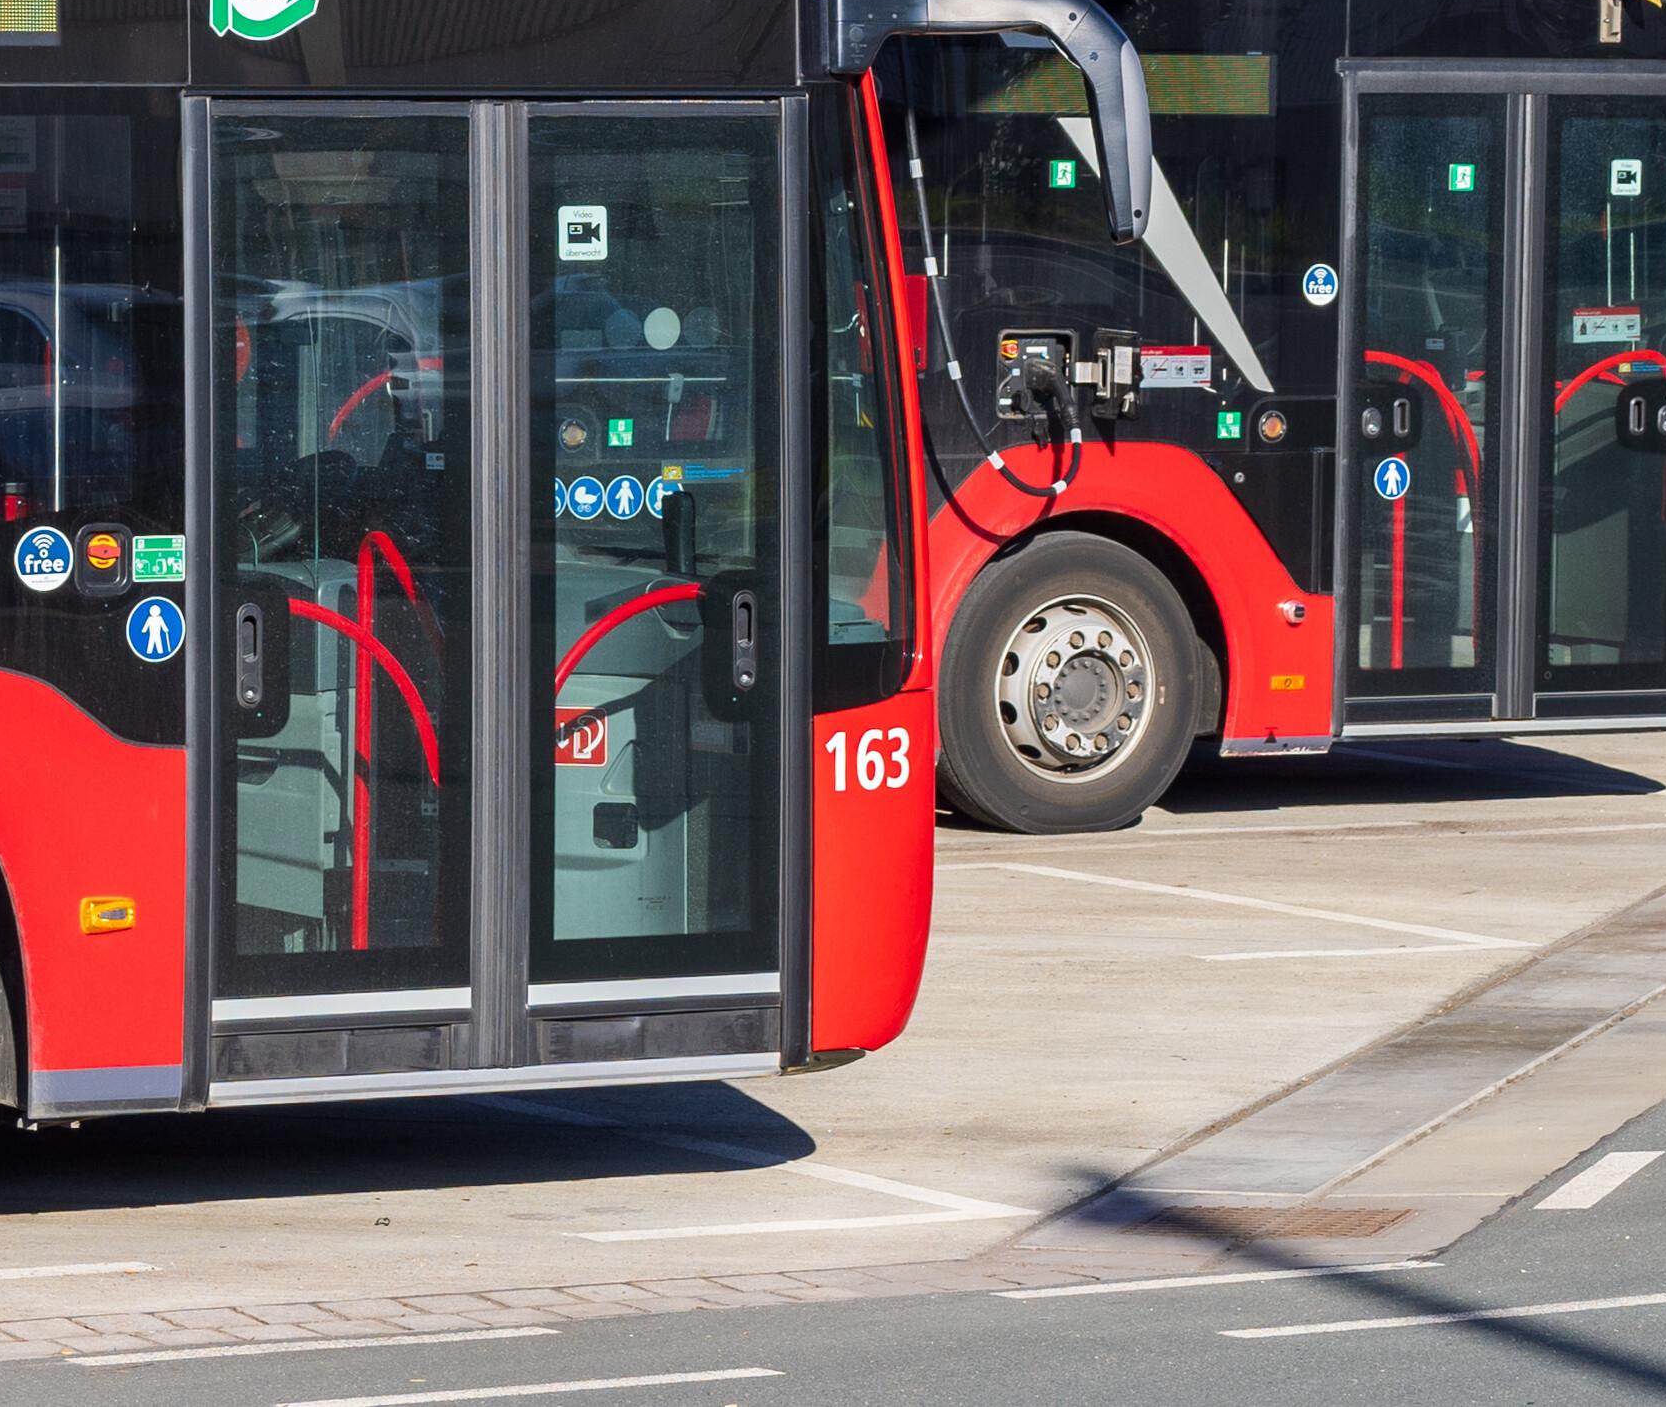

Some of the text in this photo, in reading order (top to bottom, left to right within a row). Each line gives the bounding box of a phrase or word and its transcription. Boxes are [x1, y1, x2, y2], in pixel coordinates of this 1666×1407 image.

[1309, 281, 1333, 294] free
[24, 554, 64, 574] free
[825, 726, 910, 792] 163
